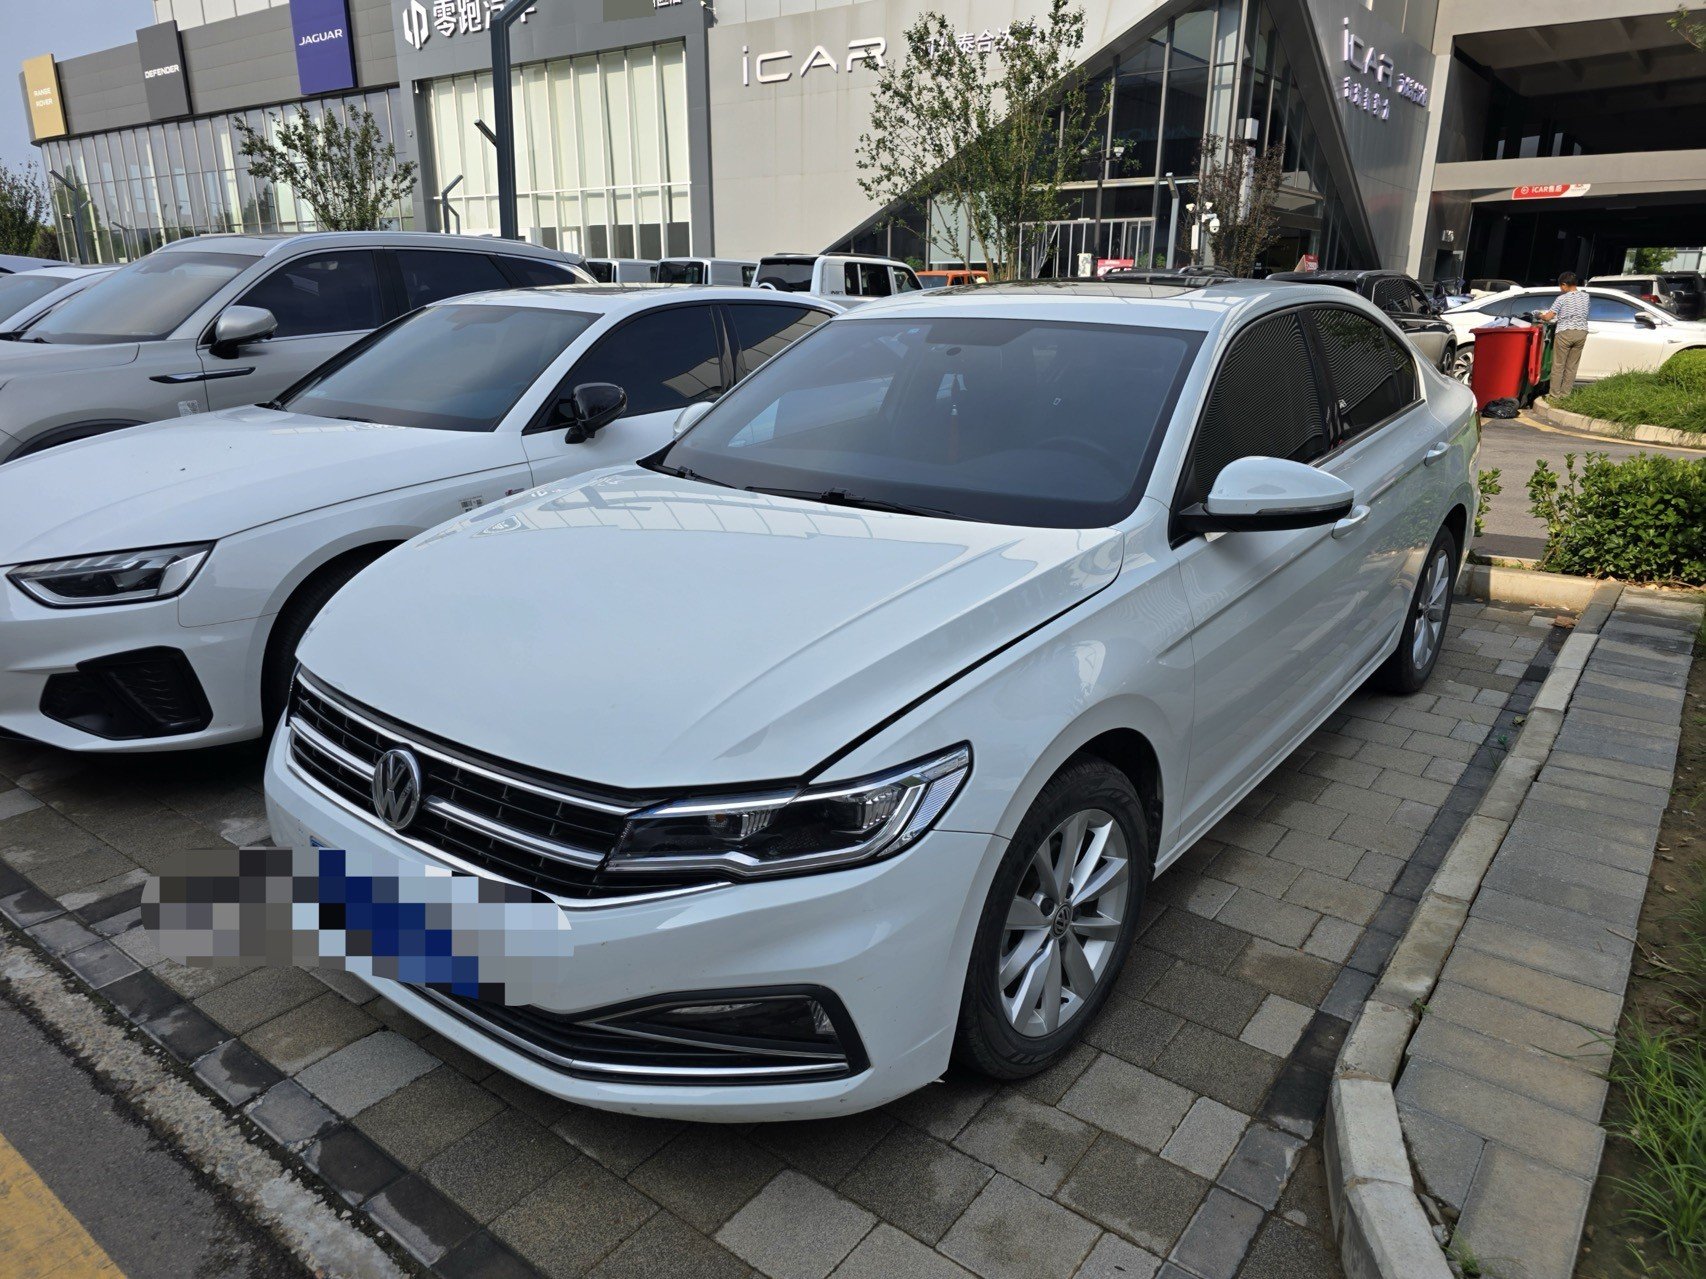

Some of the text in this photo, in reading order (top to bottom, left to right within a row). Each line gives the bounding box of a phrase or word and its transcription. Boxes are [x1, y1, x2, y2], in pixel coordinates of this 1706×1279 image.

[298, 28, 343, 46] JAGUAR
[742, 36, 887, 87] iCAR
[144, 64, 180, 79] DEFENDER
[33, 87, 51, 97] RANGE
[35, 98, 53, 107] ROVER
